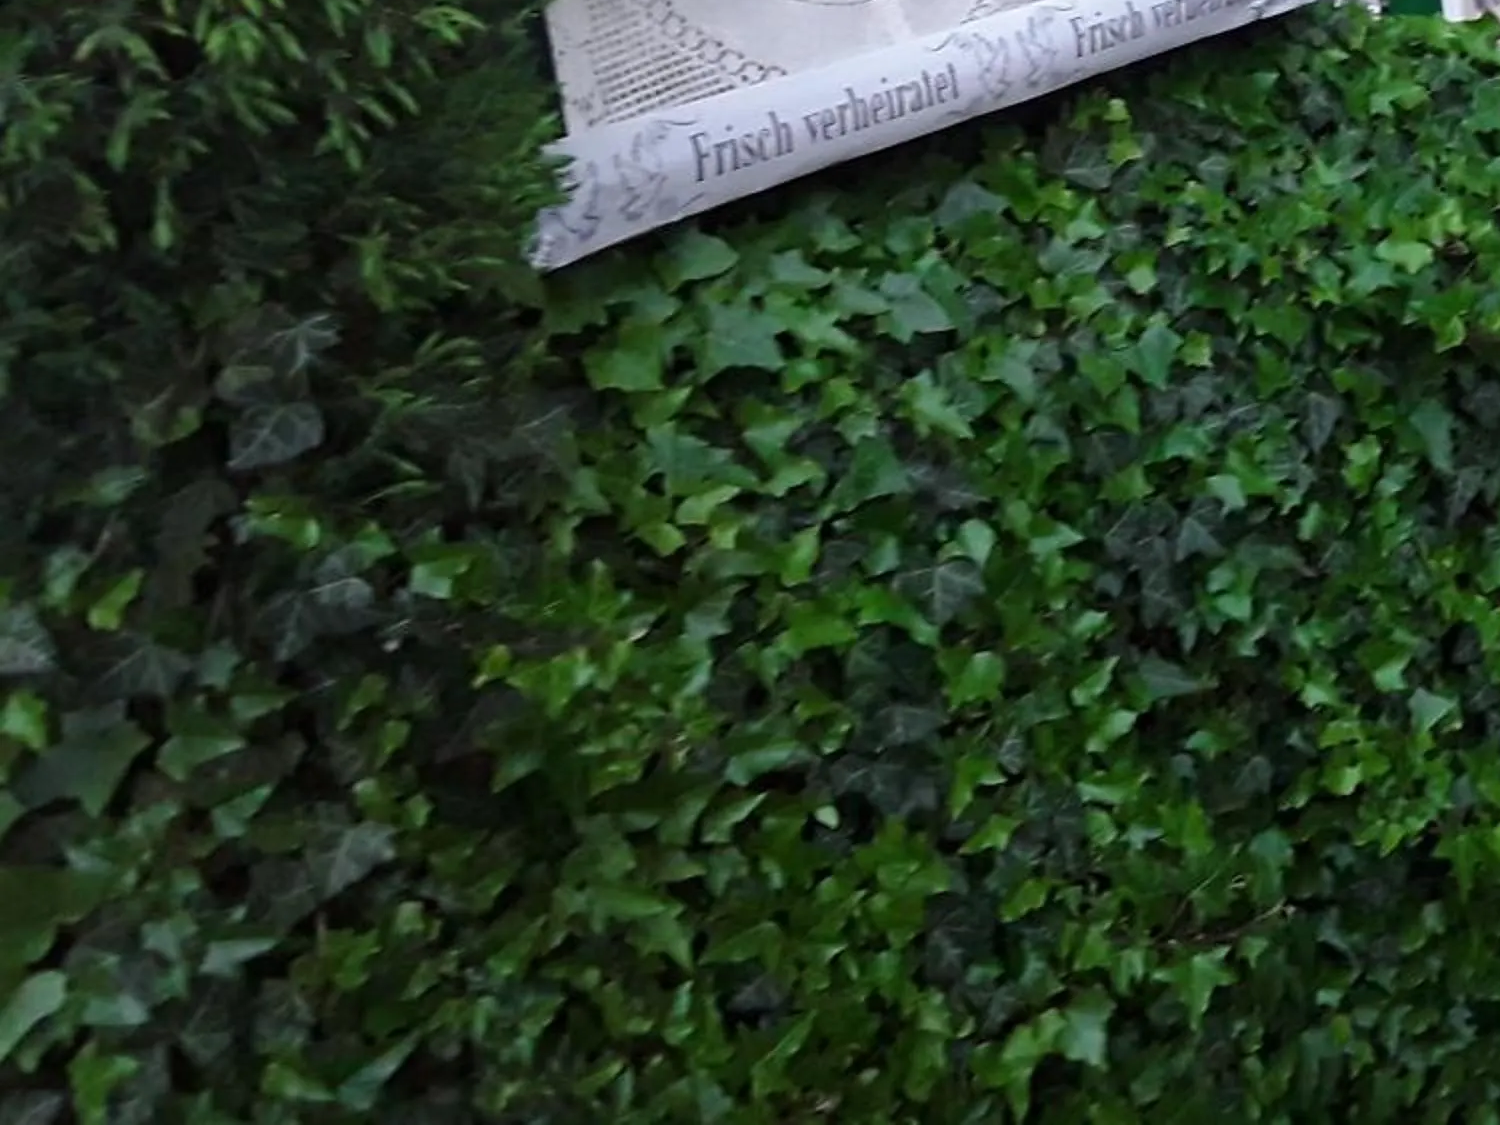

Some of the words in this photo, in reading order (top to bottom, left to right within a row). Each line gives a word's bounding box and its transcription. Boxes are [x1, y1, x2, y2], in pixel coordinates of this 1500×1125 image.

[689, 111, 793, 181] Frisch
[803, 62, 960, 143] verheiratet
[1069, 1, 1145, 57] Frisch
